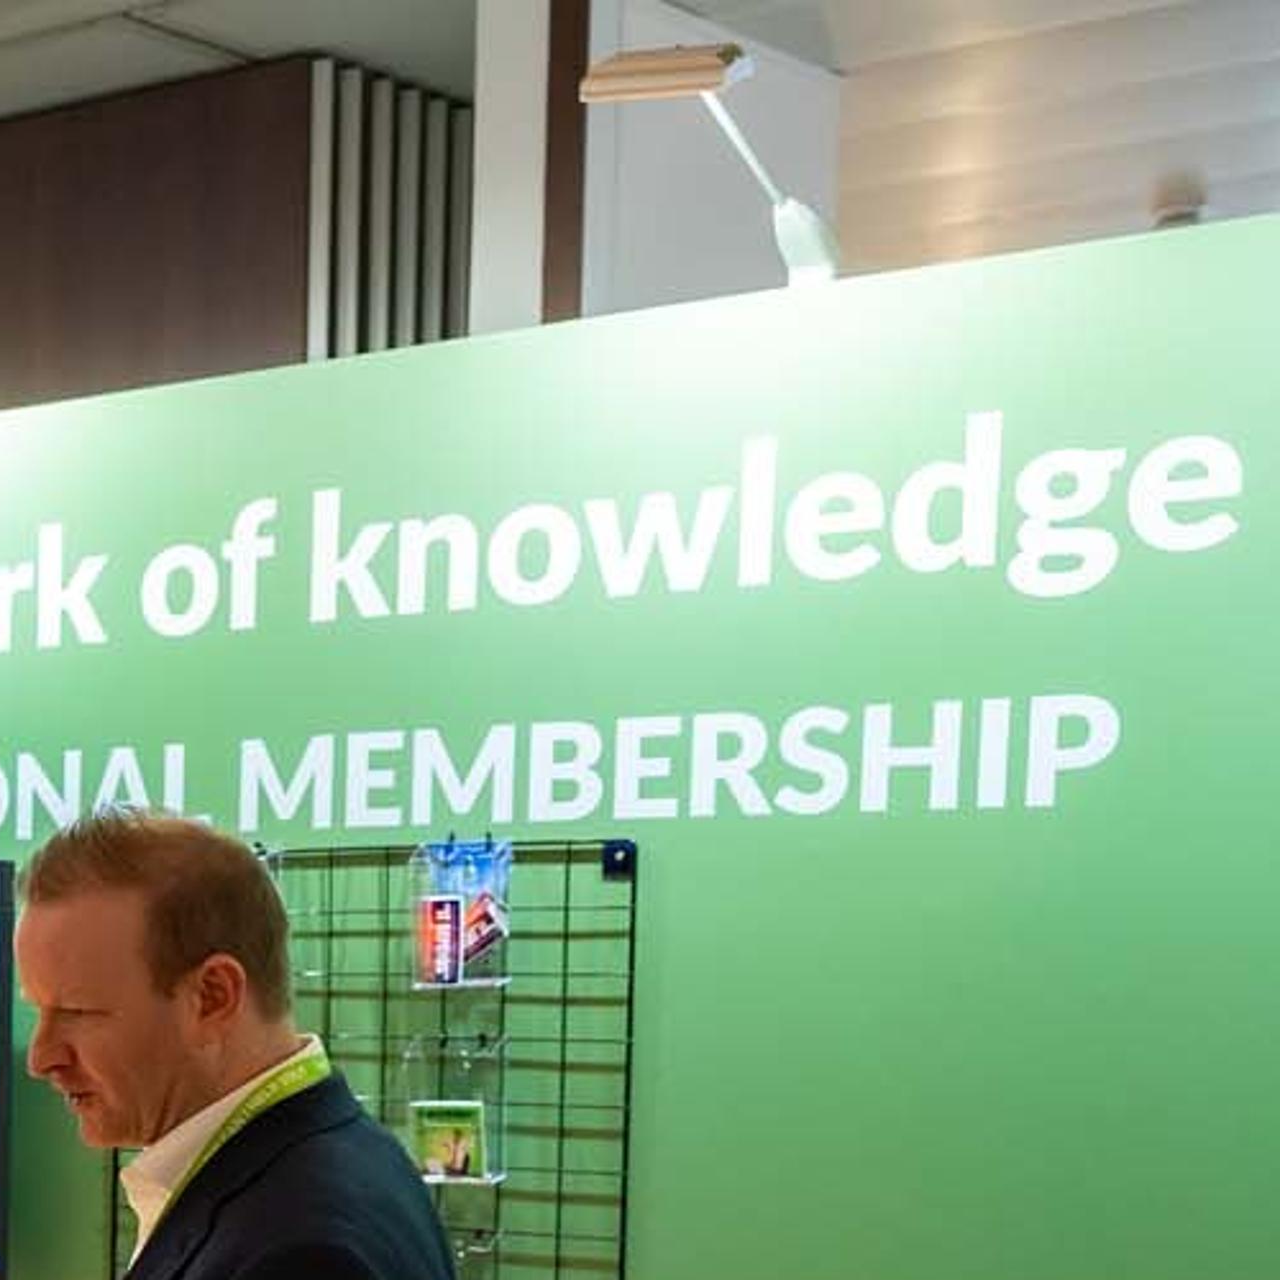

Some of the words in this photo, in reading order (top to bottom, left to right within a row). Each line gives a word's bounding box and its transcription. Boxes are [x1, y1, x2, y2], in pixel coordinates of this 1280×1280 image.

[140, 497, 279, 638] of
[308, 409, 1244, 623] knowledge
[237, 691, 1122, 832] MEMBERSHIP
